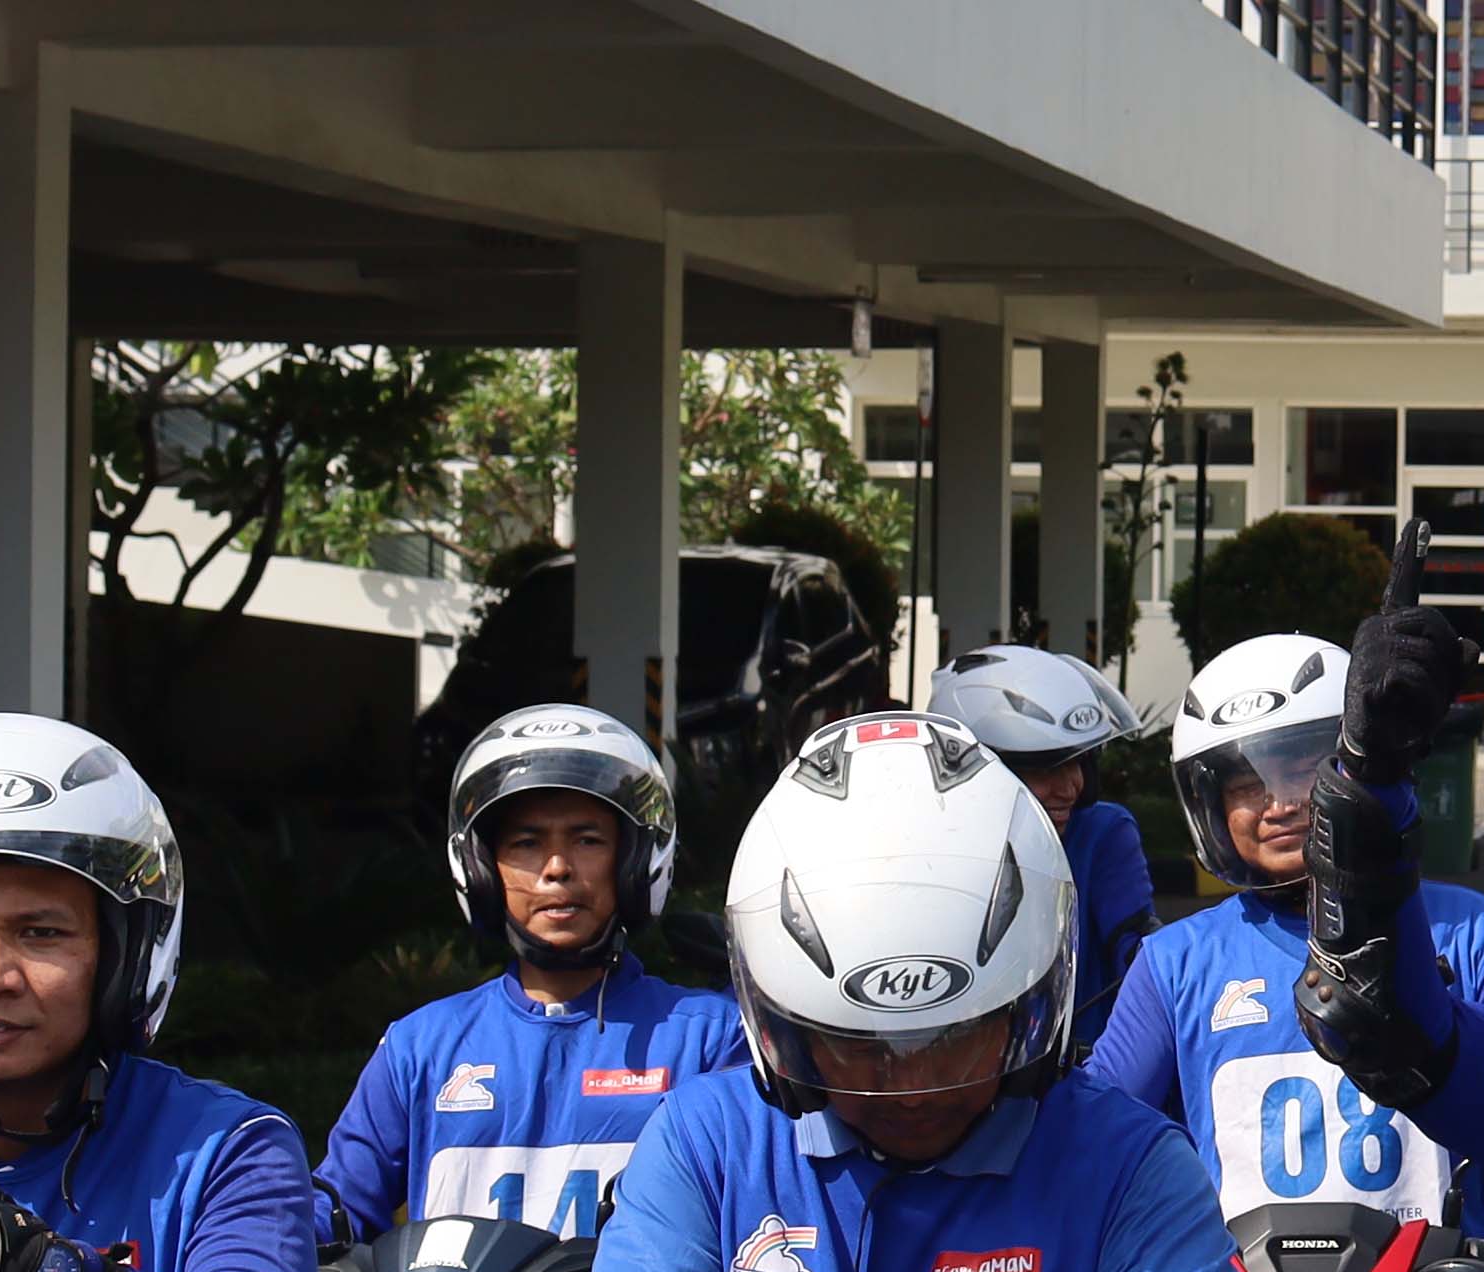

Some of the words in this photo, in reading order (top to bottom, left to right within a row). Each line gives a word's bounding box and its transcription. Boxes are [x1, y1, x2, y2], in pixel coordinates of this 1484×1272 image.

[877, 967, 939, 1000] Kyt
[1260, 1076, 1403, 1198] 08
[488, 1169, 600, 1240] 14
[1281, 1240, 1339, 1249] HONDA
